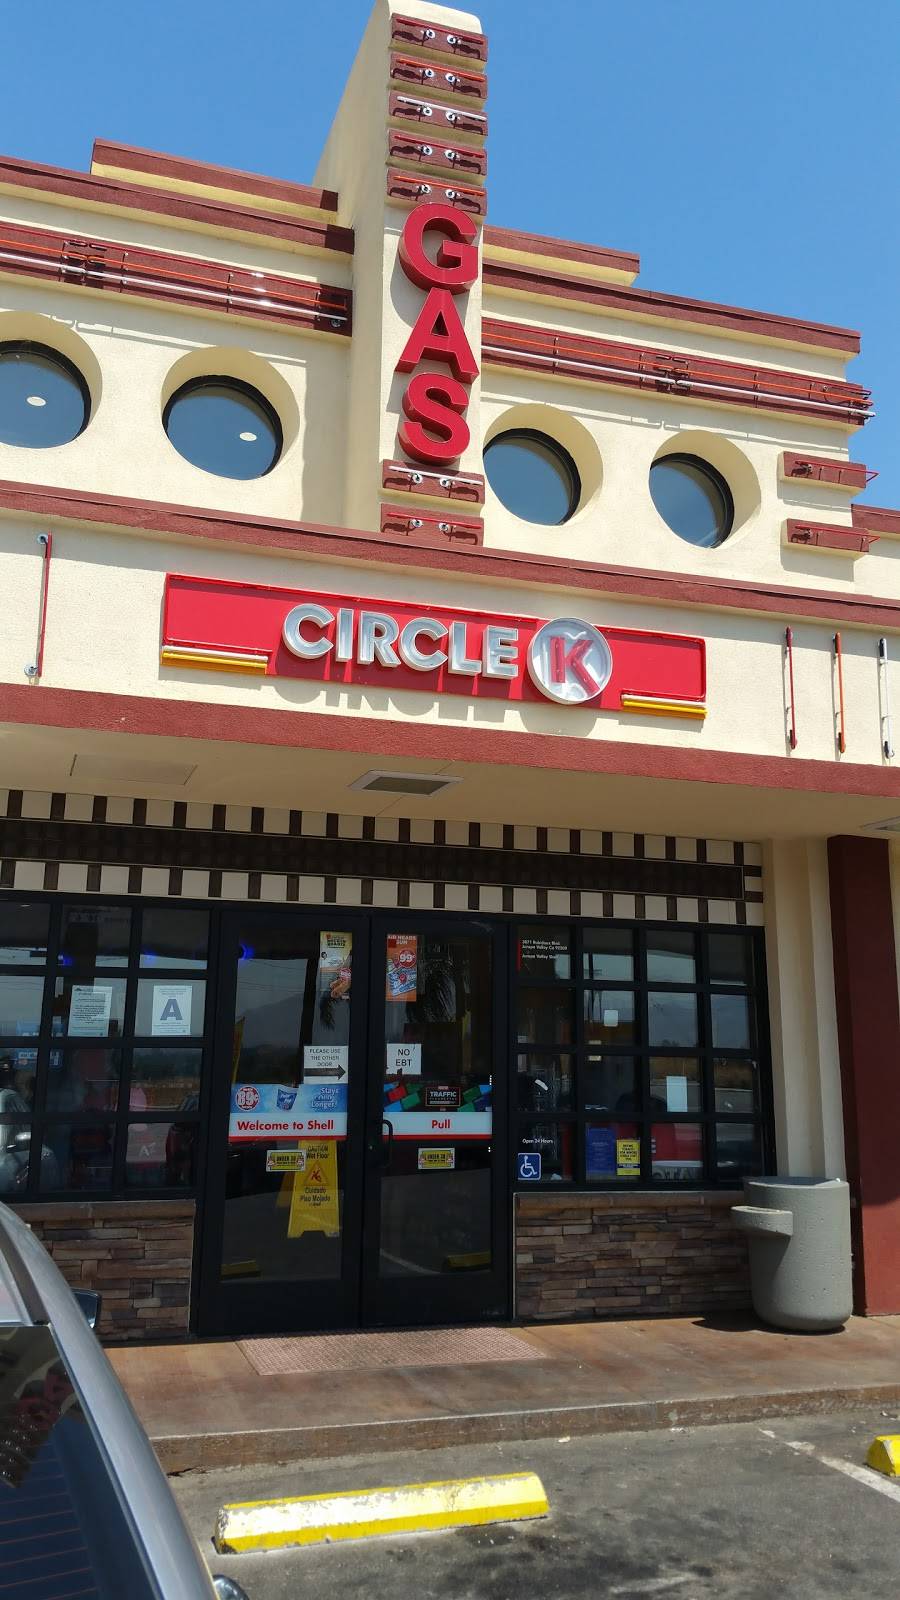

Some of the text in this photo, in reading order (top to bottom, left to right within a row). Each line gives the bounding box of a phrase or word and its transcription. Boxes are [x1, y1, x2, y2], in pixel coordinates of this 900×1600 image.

[395, 202, 480, 467] GAS
[282, 603, 601, 698] CIRCLE K
[160, 998, 183, 1021] A
[395, 1059, 412, 1067] EBT
[320, 1087, 339, 1095] Stays
[237, 1119, 334, 1131] Welcome to Shell
[431, 1119, 451, 1129] Pull
